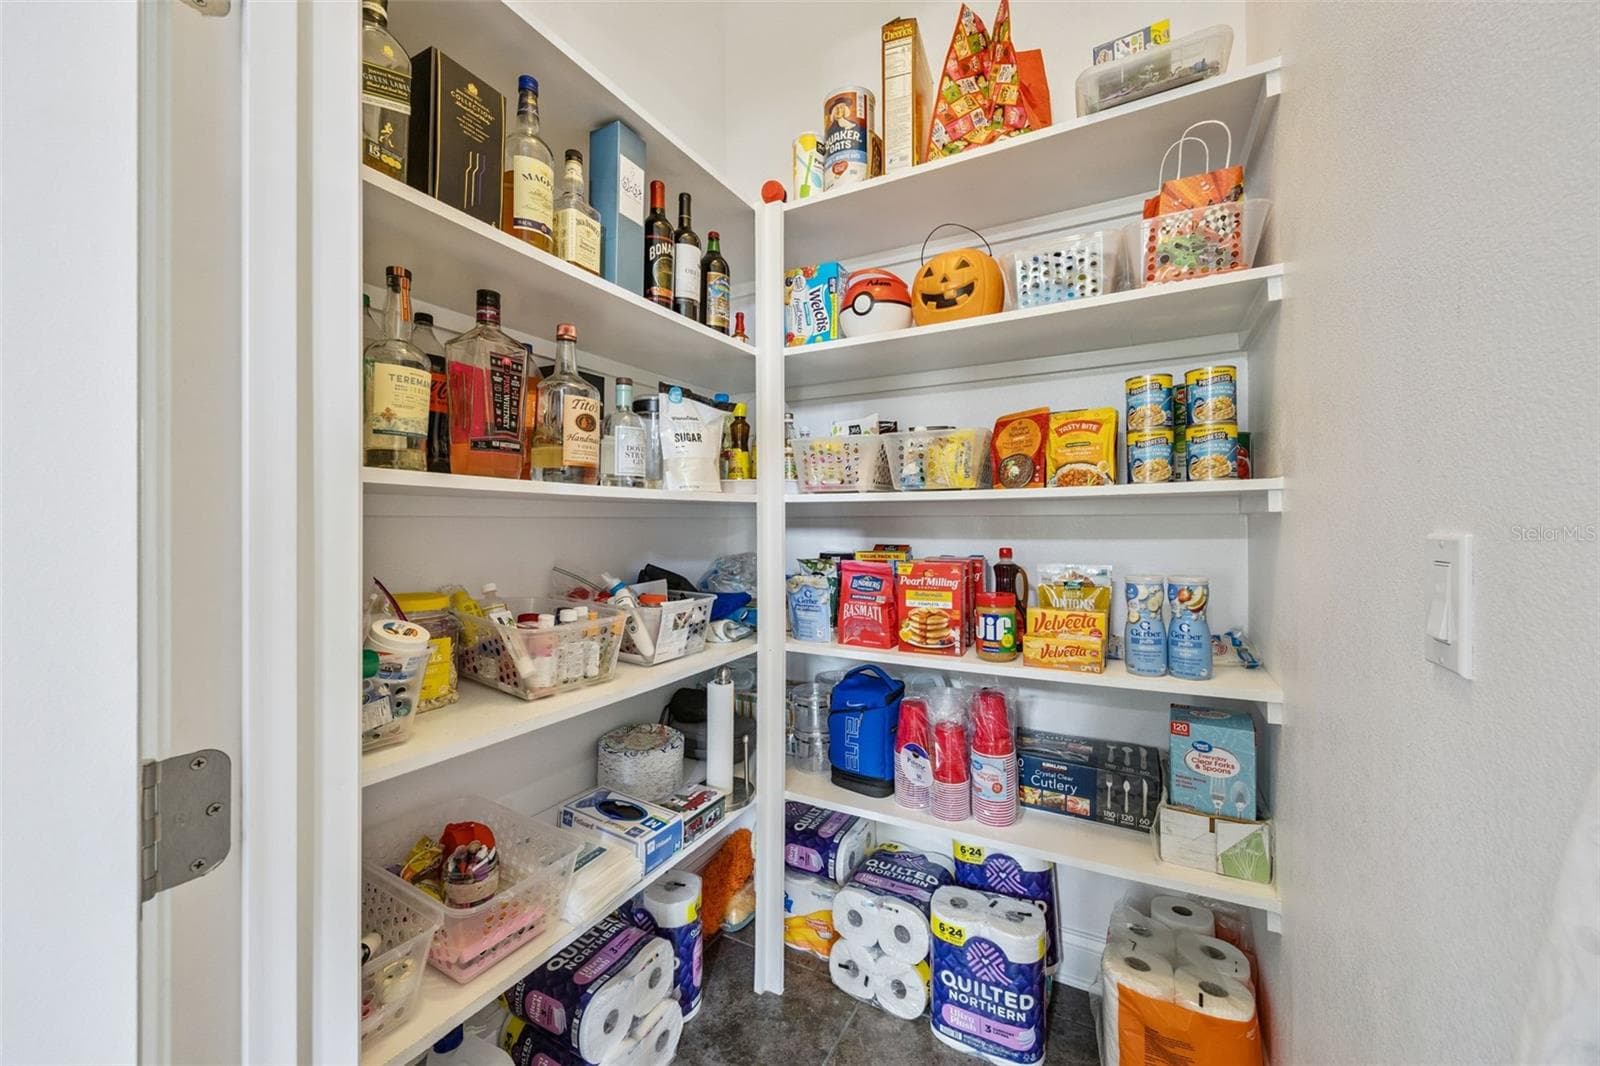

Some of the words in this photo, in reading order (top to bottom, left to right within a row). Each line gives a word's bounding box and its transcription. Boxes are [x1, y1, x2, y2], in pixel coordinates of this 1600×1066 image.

[883, 27, 913, 42] Cheerios
[808, 287, 827, 332] Welch's
[1060, 421, 1082, 434] TASTY
[1082, 422, 1098, 431] BITE
[566, 435, 599, 445] Handma
[674, 432, 703, 444] SUGAR
[900, 575, 924, 585] Pearl
[926, 577, 959, 590] Milling
[843, 603, 882, 624] BASMATI
[1033, 611, 1097, 634] Velveeta
[1130, 628, 1162, 638] Gerber
[1040, 643, 1087, 659] Velveeta
[1171, 722, 1188, 732] 120
[1191, 757, 1213, 766] Clear
[1213, 760, 1236, 770] Forks
[1202, 764, 1232, 775] Spoons
[1034, 769, 1056, 779] Crystal
[1056, 772, 1074, 781] Clear
[1030, 775, 1078, 795] Cutlery
[793, 806, 823, 832] QUILT
[808, 808, 831, 831] NORTH
[1103, 809, 1116, 819] 180
[1120, 812, 1134, 822] 120
[1139, 818, 1150, 826] 60
[865, 857, 940, 886] QUILTED
[866, 866, 930, 888] NORTHERN
[546, 910, 622, 972] QUILTE
[565, 921, 626, 971] NORTHERN
[940, 968, 1034, 1012] QUILTED
[948, 989, 1027, 1023] NORTHERN
[949, 1008, 976, 1024] Ultra
[949, 1015, 977, 1033] Plush
[984, 1024, 992, 1034] 3
